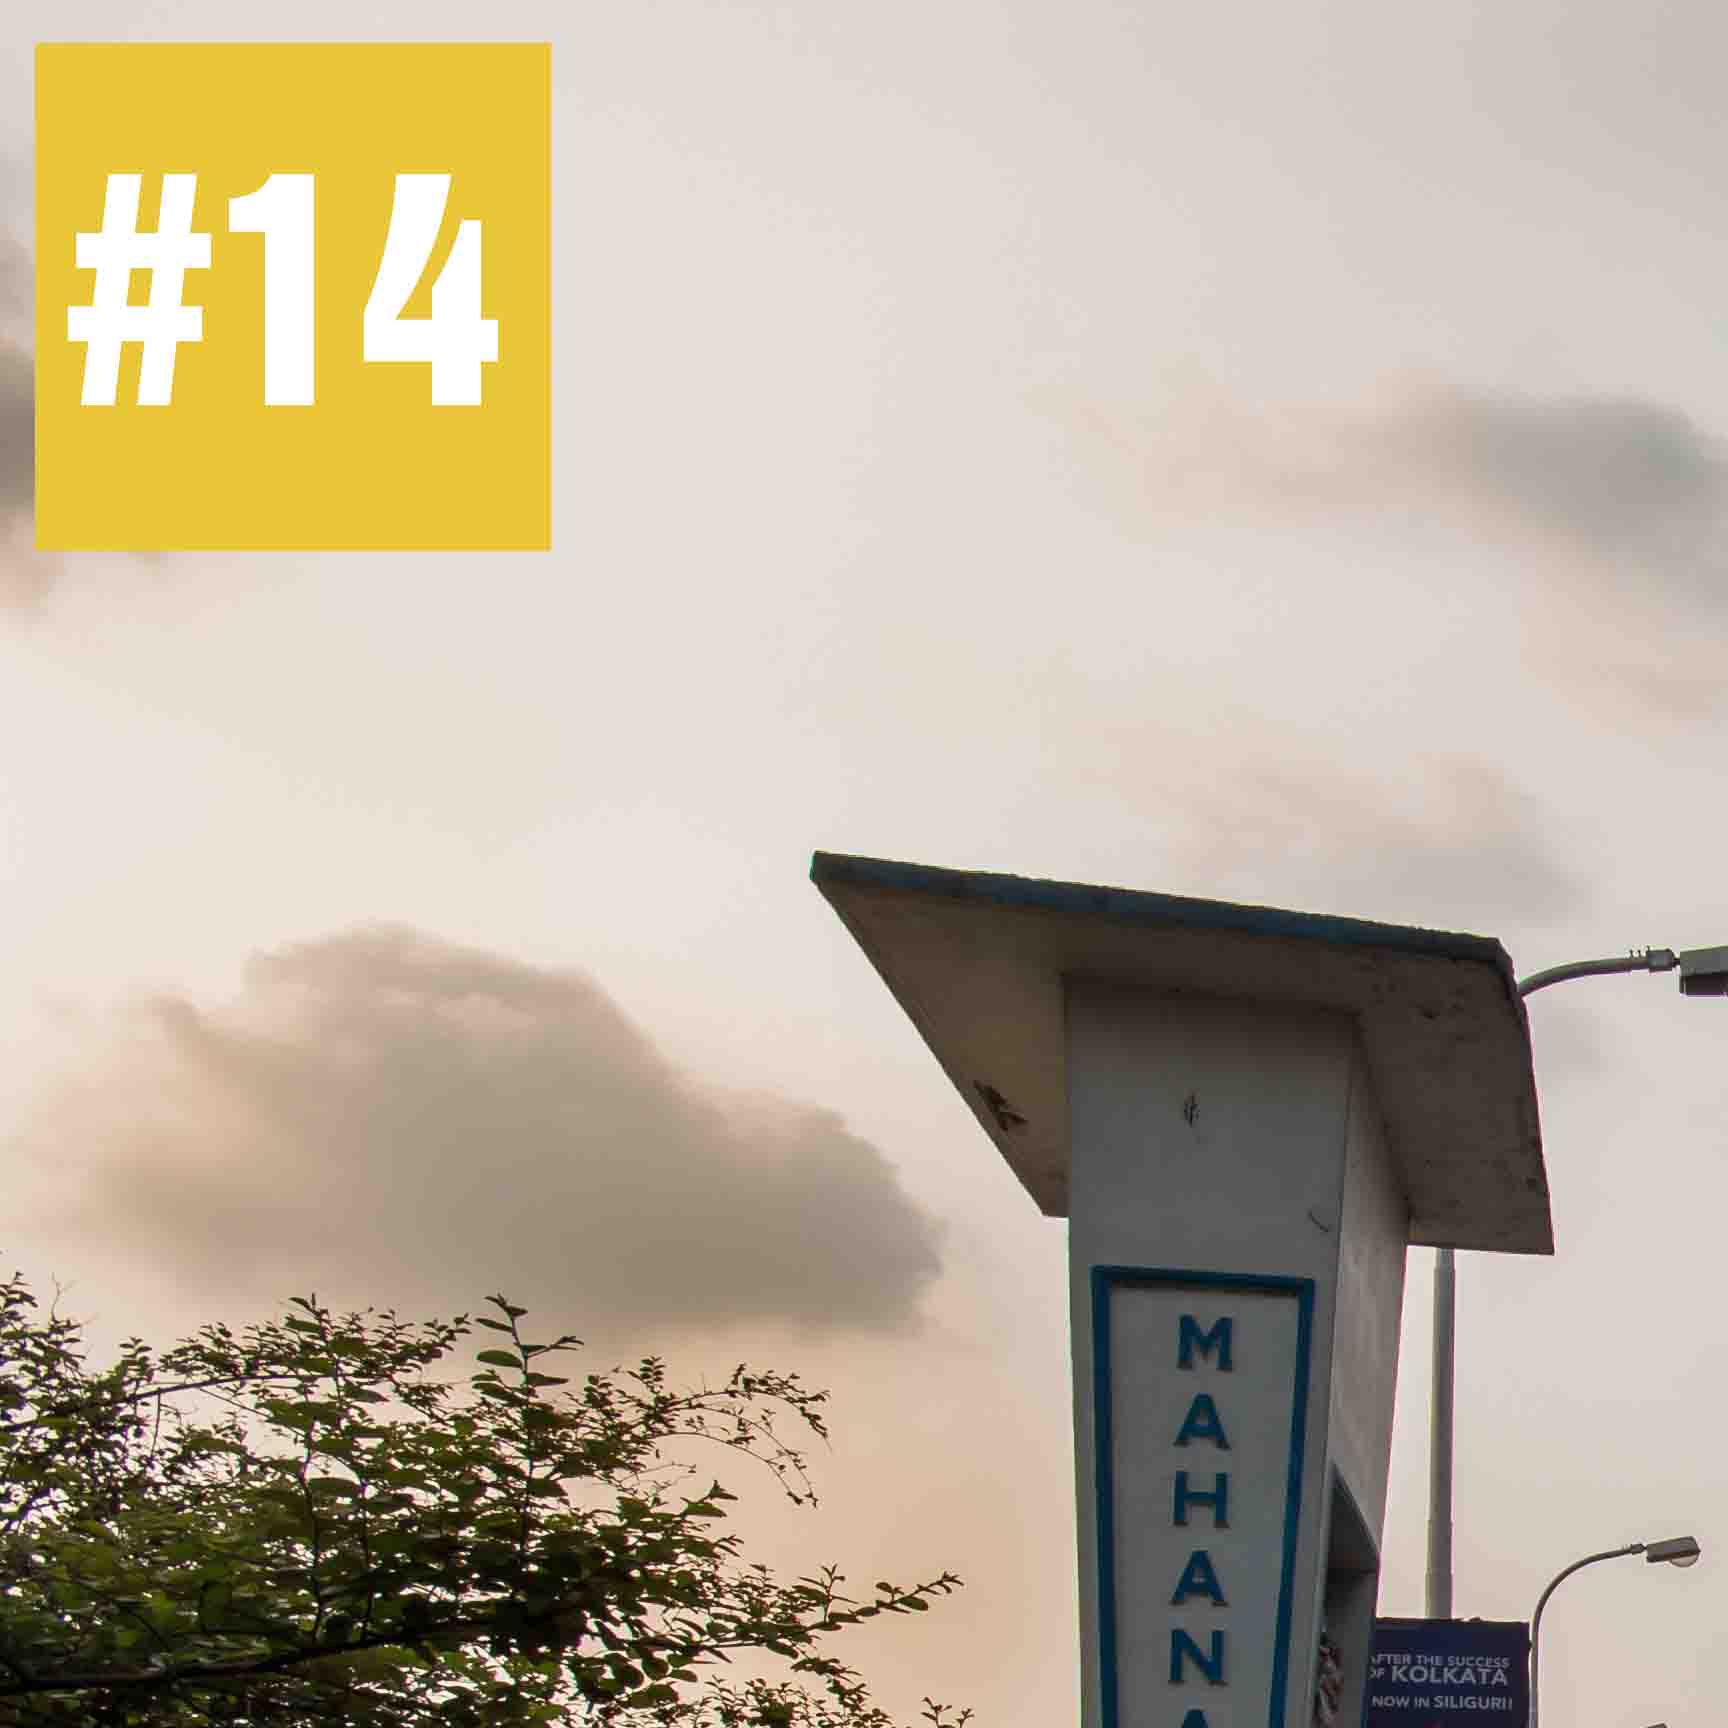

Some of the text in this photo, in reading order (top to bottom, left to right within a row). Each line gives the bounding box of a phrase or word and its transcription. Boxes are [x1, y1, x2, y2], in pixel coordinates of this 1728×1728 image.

[1416, 1654, 1443, 1666] THE
[1447, 1655, 1511, 1668] SUCCESS
[1391, 1665, 1508, 1687] KOLKATA
[1372, 1695, 1409, 1709] NOW
[1414, 1696, 1430, 1709] IN
